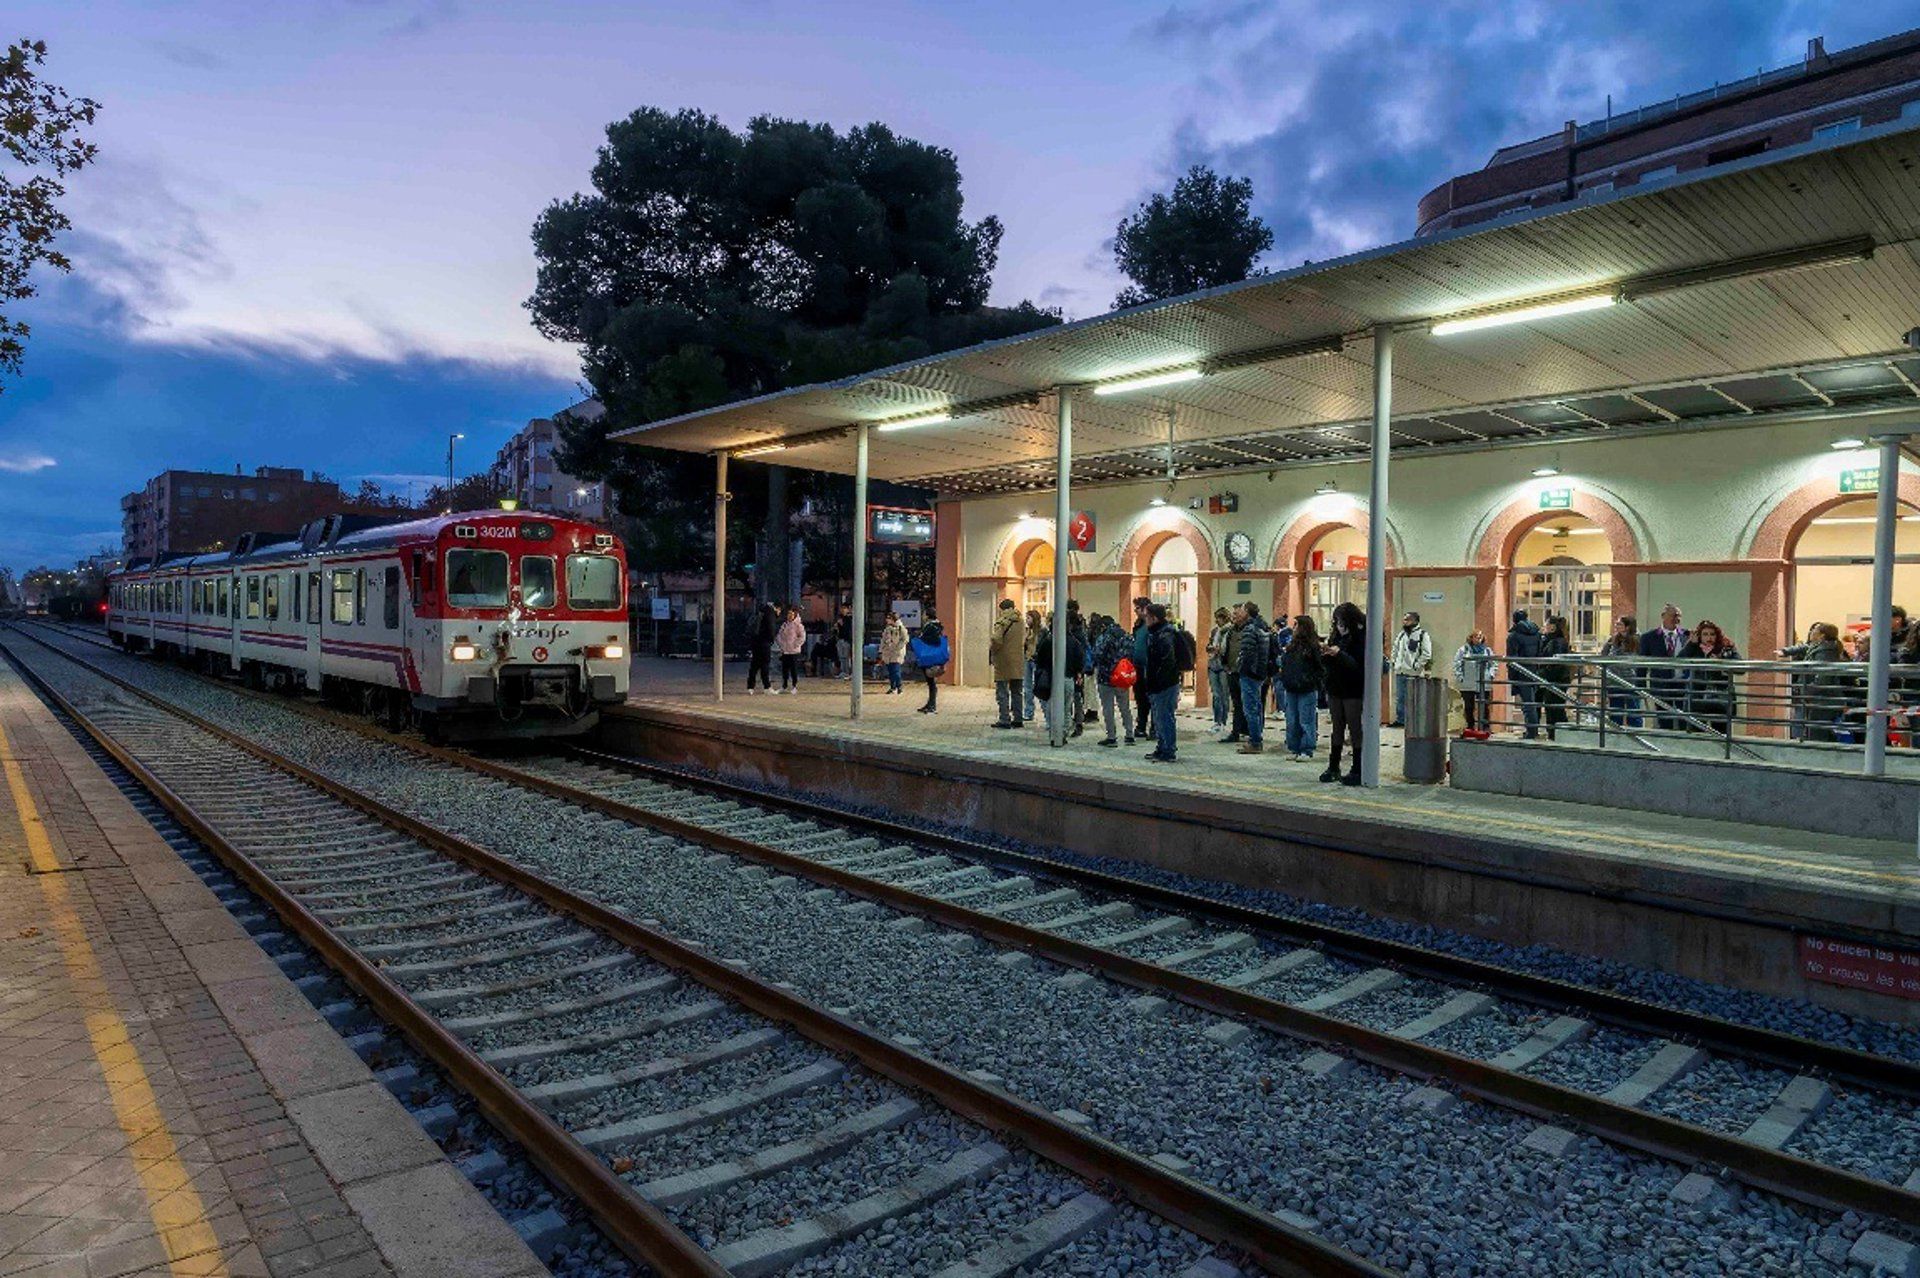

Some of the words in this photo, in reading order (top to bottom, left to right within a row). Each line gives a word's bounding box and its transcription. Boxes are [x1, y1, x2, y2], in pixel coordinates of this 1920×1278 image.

[479, 525, 517, 538] 302M
[1076, 520, 1087, 541] 2
[515, 623, 570, 644] renfe
[1807, 937, 1824, 951] No
[1828, 942, 1871, 959] crucen
[1875, 948, 1894, 962] las
[1807, 960, 1824, 974] No
